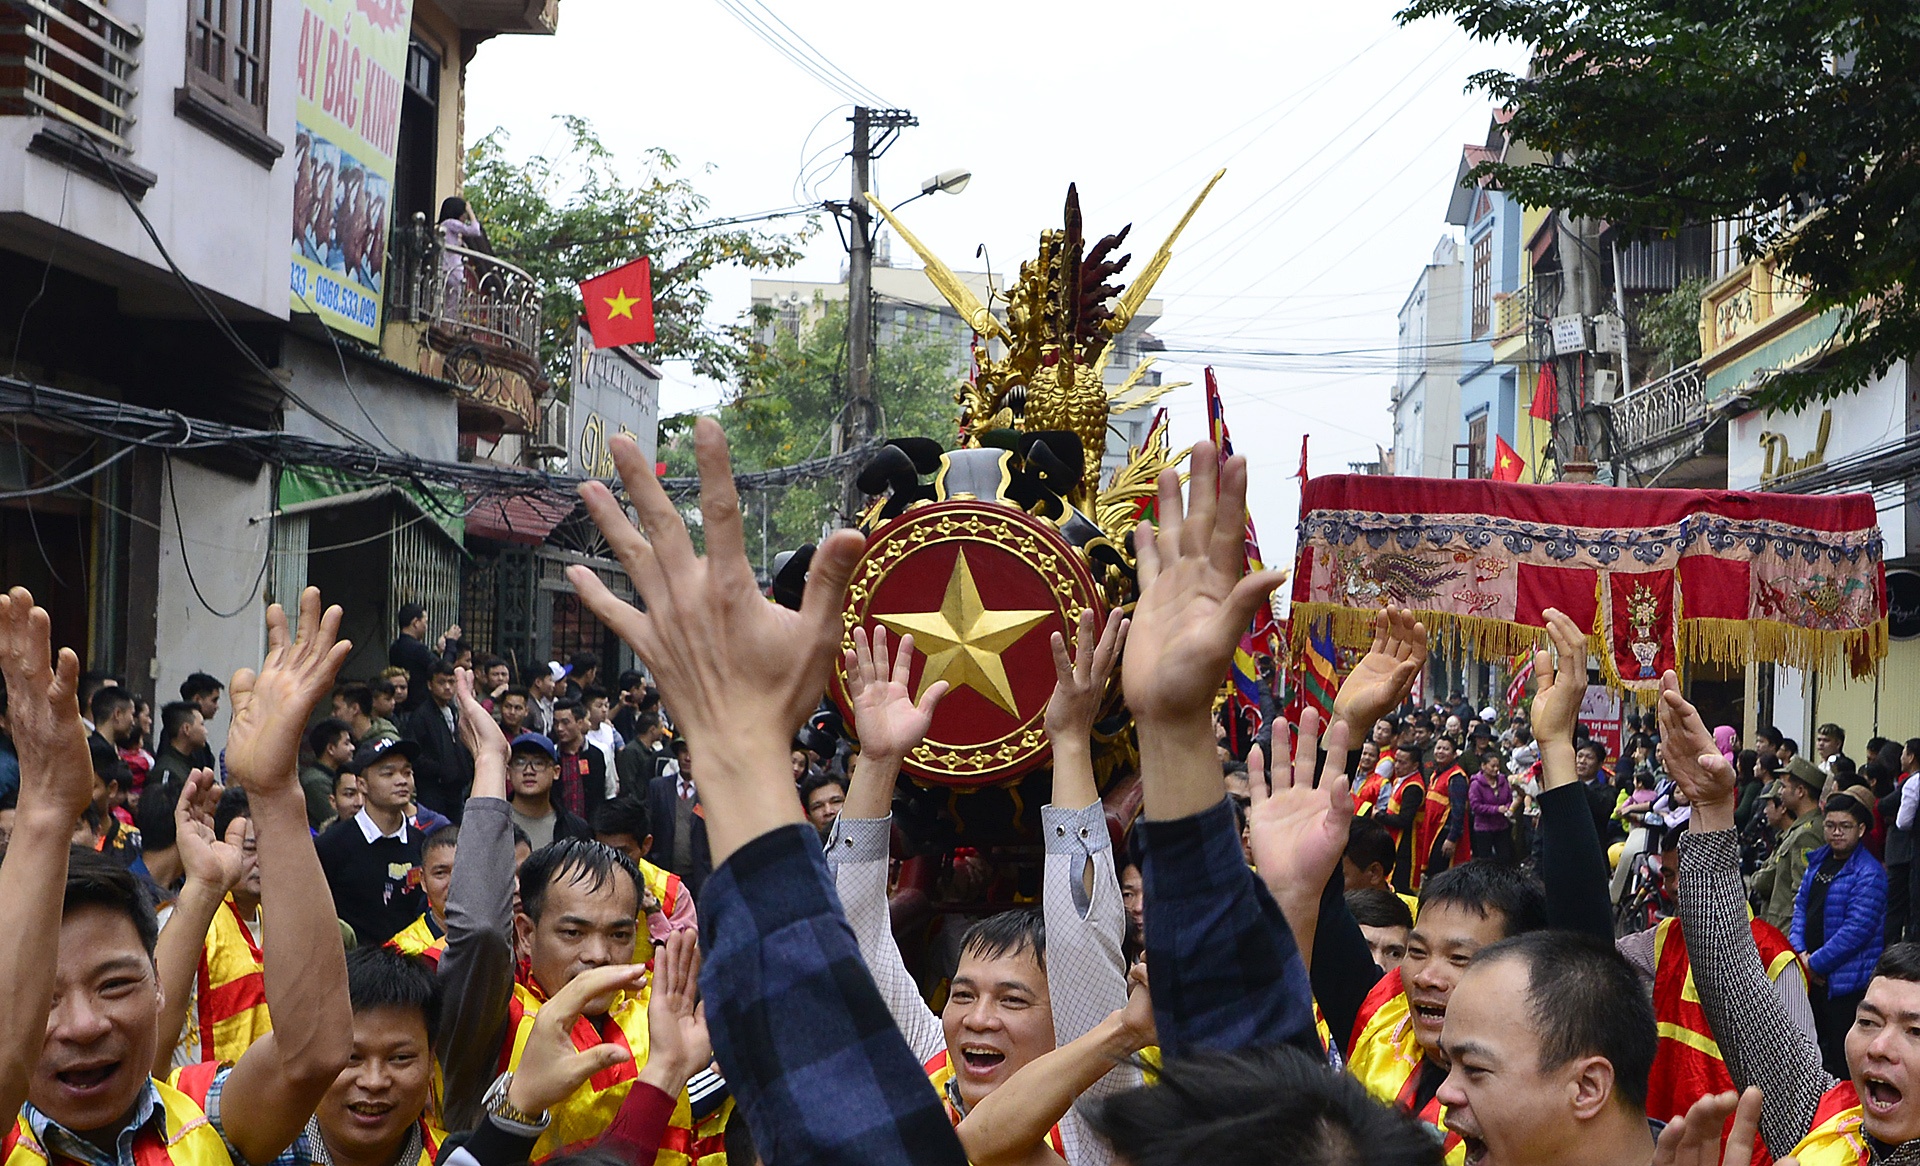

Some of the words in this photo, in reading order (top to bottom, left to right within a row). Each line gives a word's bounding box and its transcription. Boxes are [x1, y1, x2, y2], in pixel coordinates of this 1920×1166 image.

[323, 11, 361, 129] BẮC
[361, 58, 399, 158] KINH
[316, 275, 376, 328] 0968.533.099
